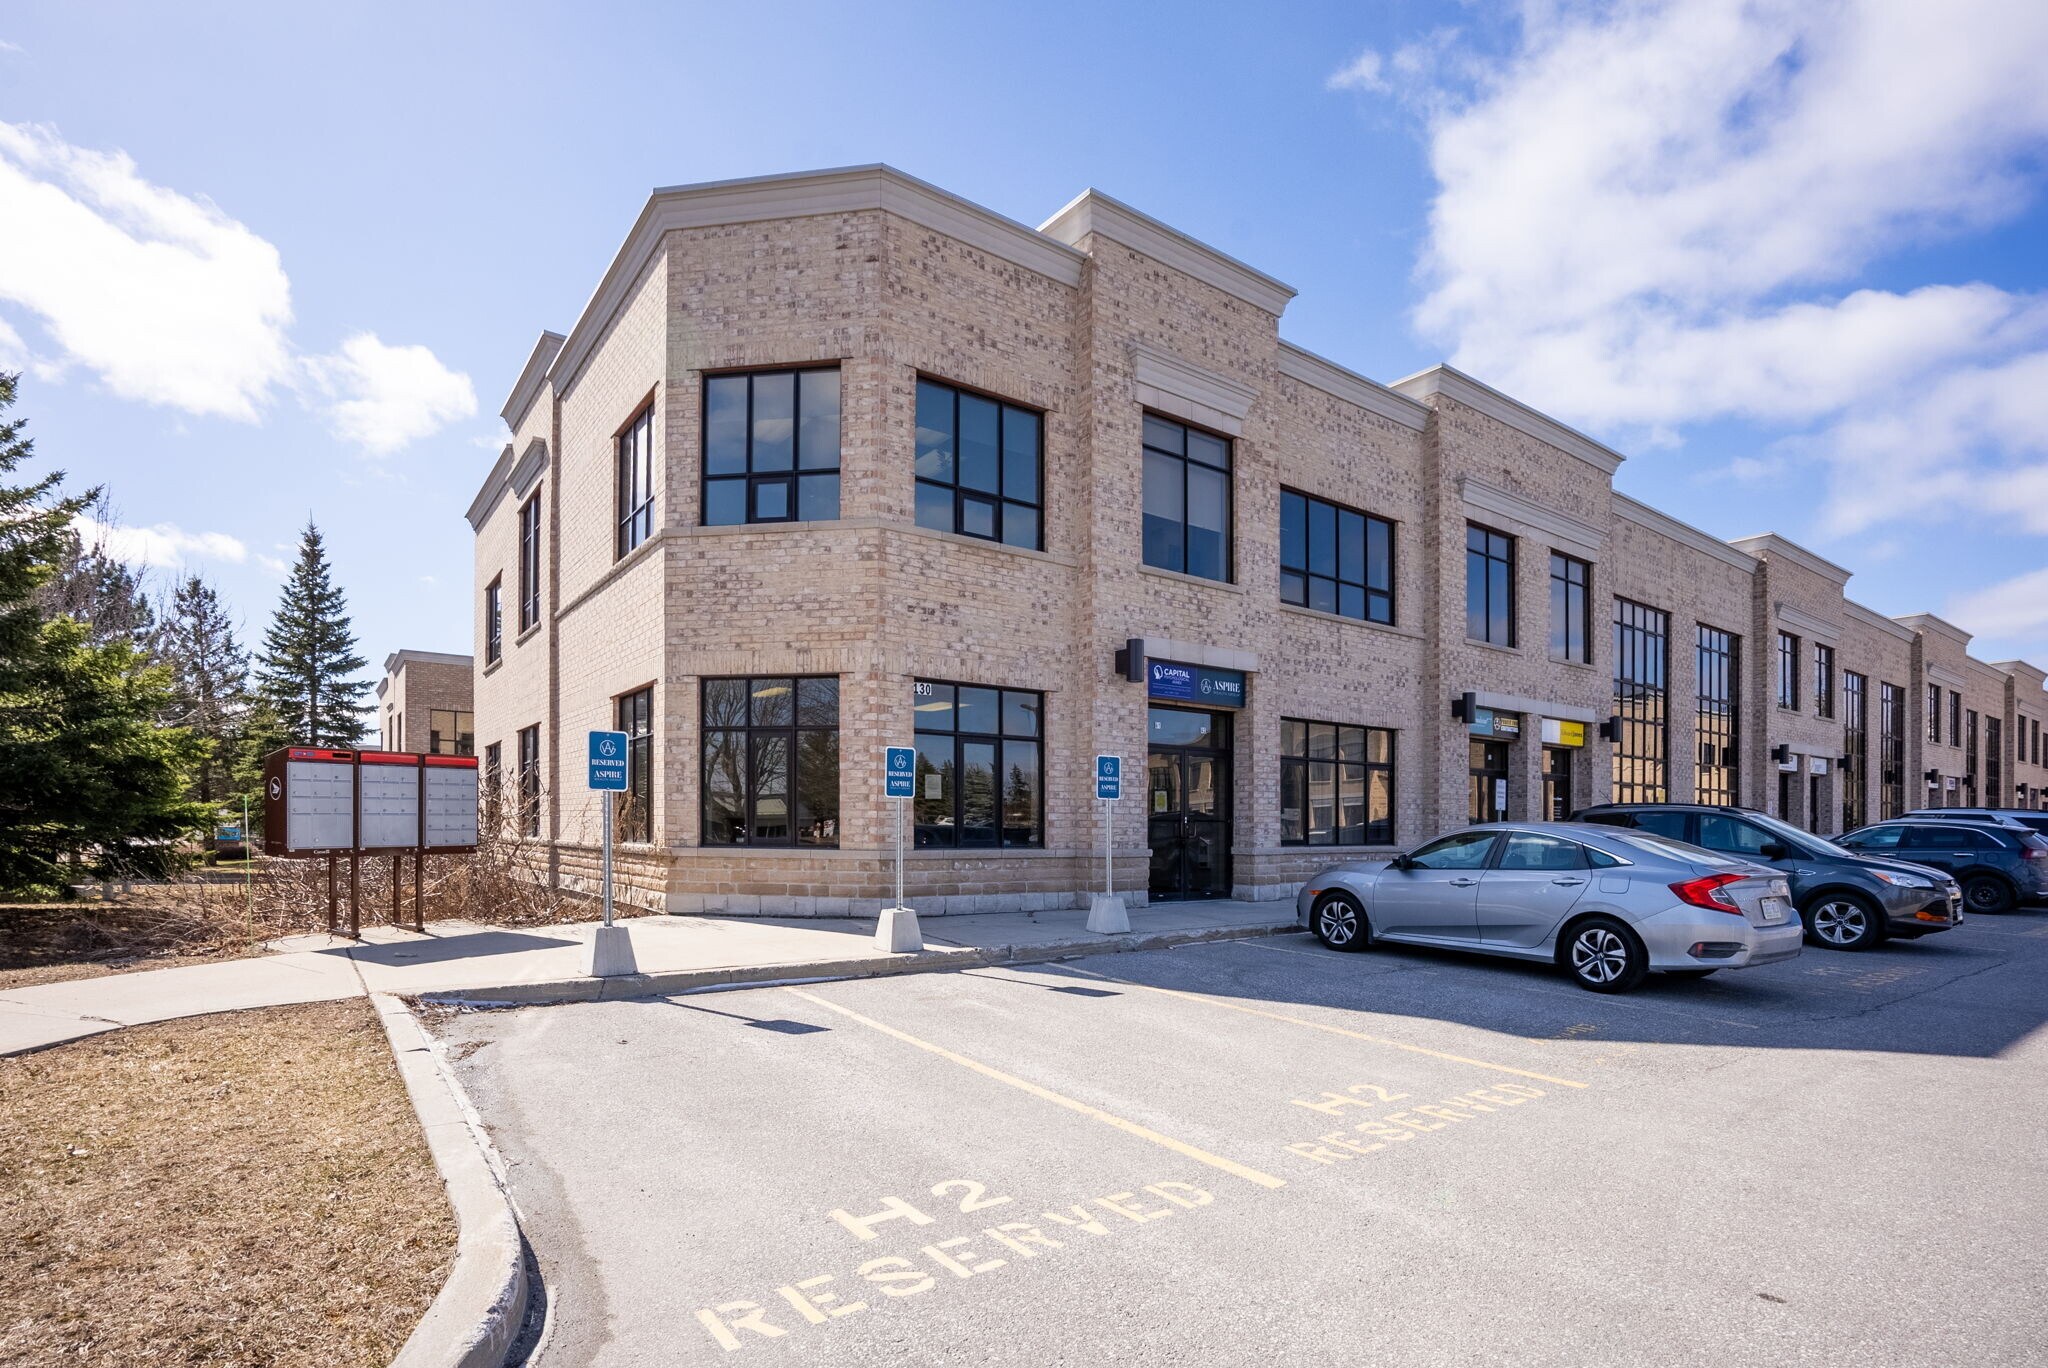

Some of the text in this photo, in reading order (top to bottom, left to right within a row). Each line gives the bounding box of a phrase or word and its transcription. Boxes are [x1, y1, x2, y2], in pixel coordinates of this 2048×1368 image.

[1164, 668, 1190, 678] CAPITAL
[914, 683, 931, 695] 130
[1213, 680, 1240, 693] ASPIRE
[591, 758, 624, 767] RESERVED
[594, 770, 622, 778] ASPIRE
[1290, 1084, 1410, 1115] H2
[1284, 1083, 1546, 1164] RESERVED
[828, 1179, 1013, 1241] H2
[694, 1181, 1215, 1352] RESERVED
